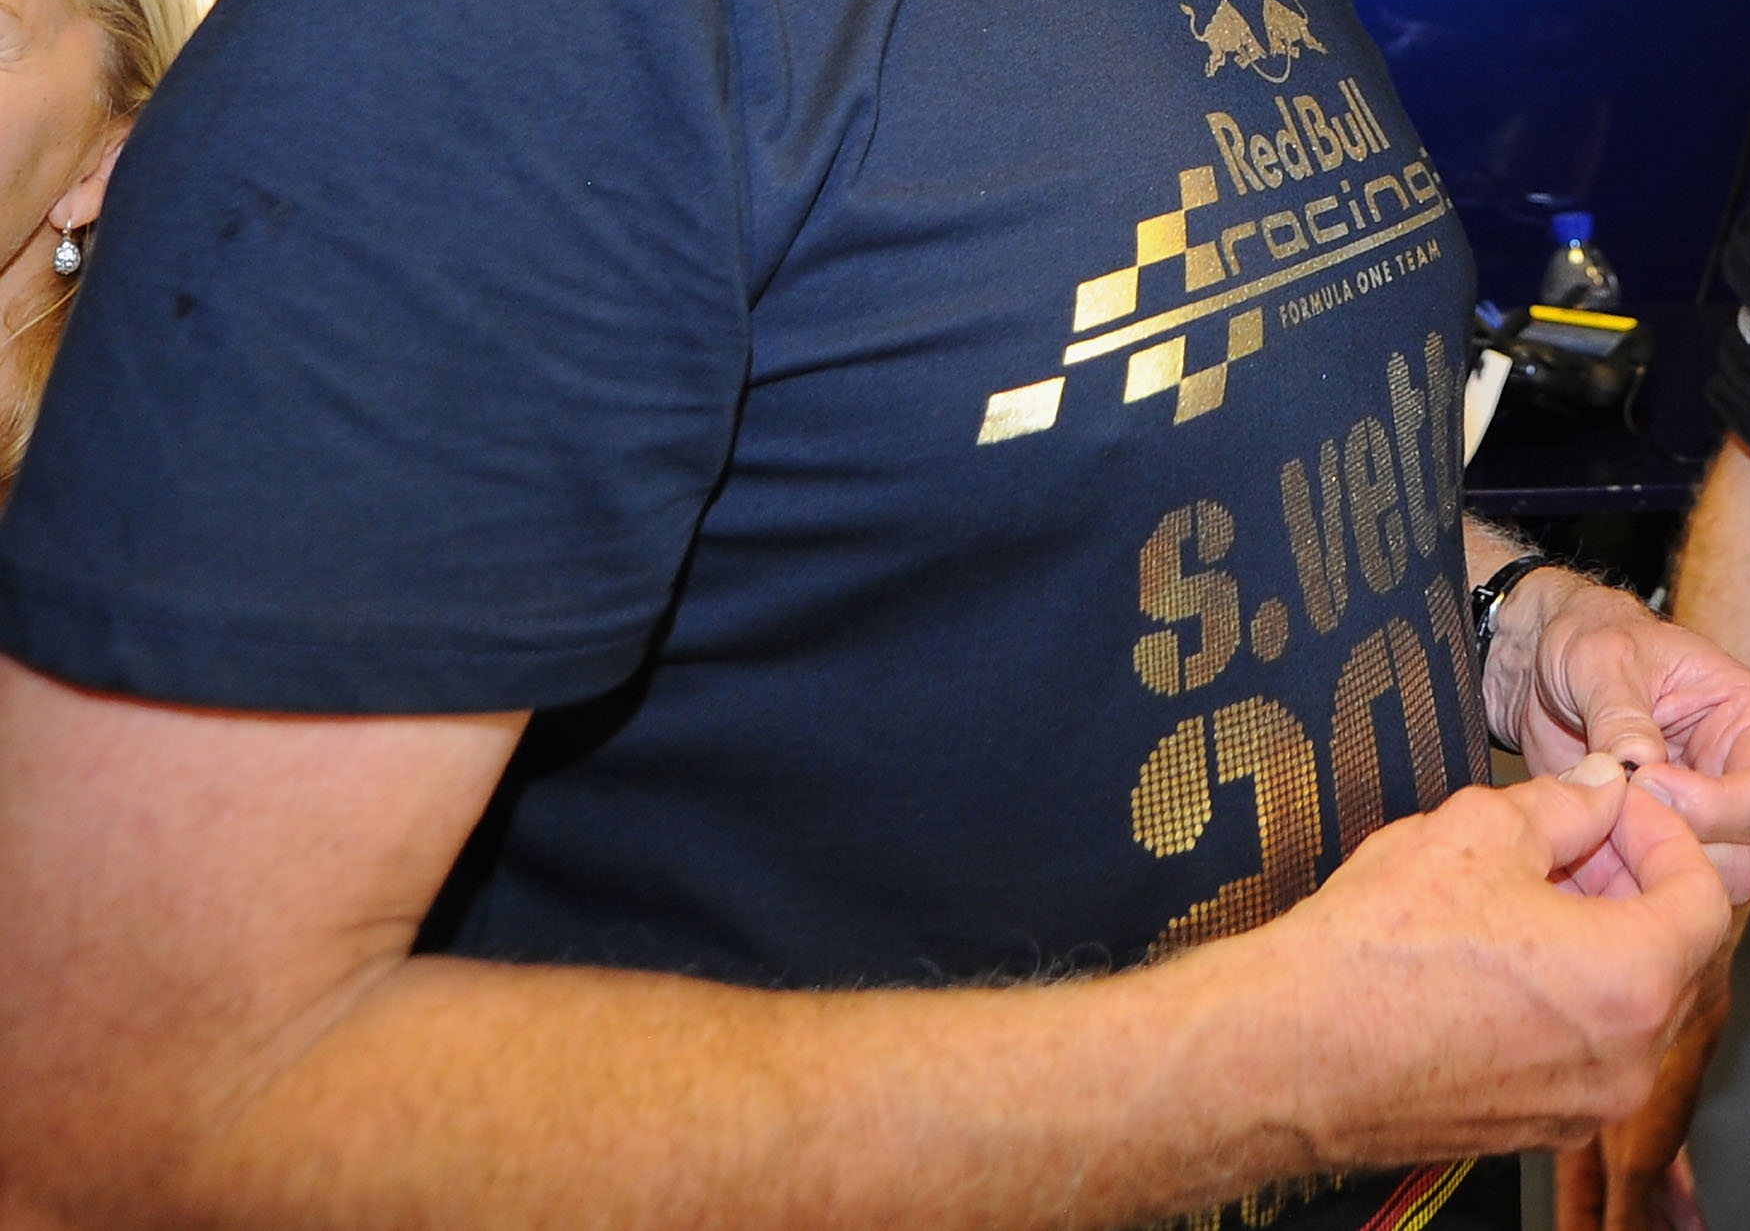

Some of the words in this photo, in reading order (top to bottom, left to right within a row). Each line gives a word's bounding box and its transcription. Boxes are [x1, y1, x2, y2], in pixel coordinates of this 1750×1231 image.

[1206, 95, 1312, 197] Red
[1295, 77, 1390, 171] Bull
[1222, 158, 1452, 276] racing
[1279, 277, 1354, 329] FORMULA
[1356, 260, 1395, 297] ONE
[1396, 239, 1443, 281] TEAM
